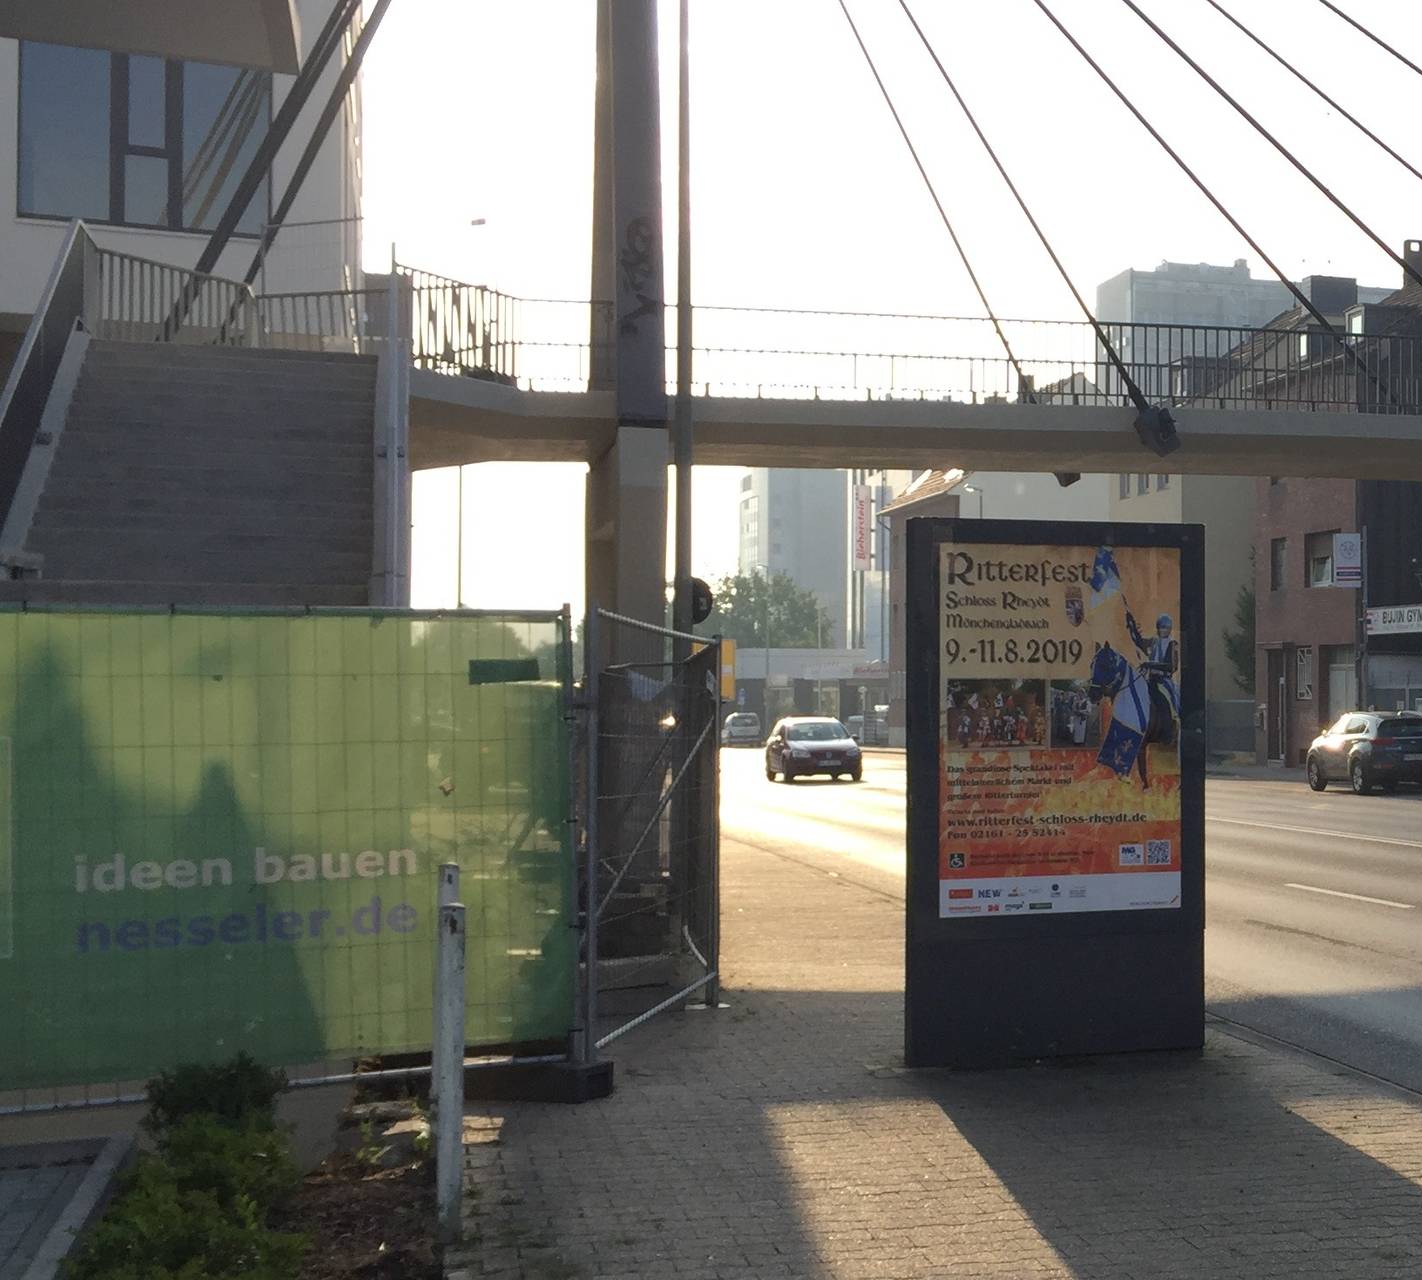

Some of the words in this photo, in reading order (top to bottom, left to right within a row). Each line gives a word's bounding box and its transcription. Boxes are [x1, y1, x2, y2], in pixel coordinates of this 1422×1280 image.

[75, 853, 233, 893] ideen
[255, 847, 417, 886] bauen
[76, 896, 418, 954] nesseler.de
